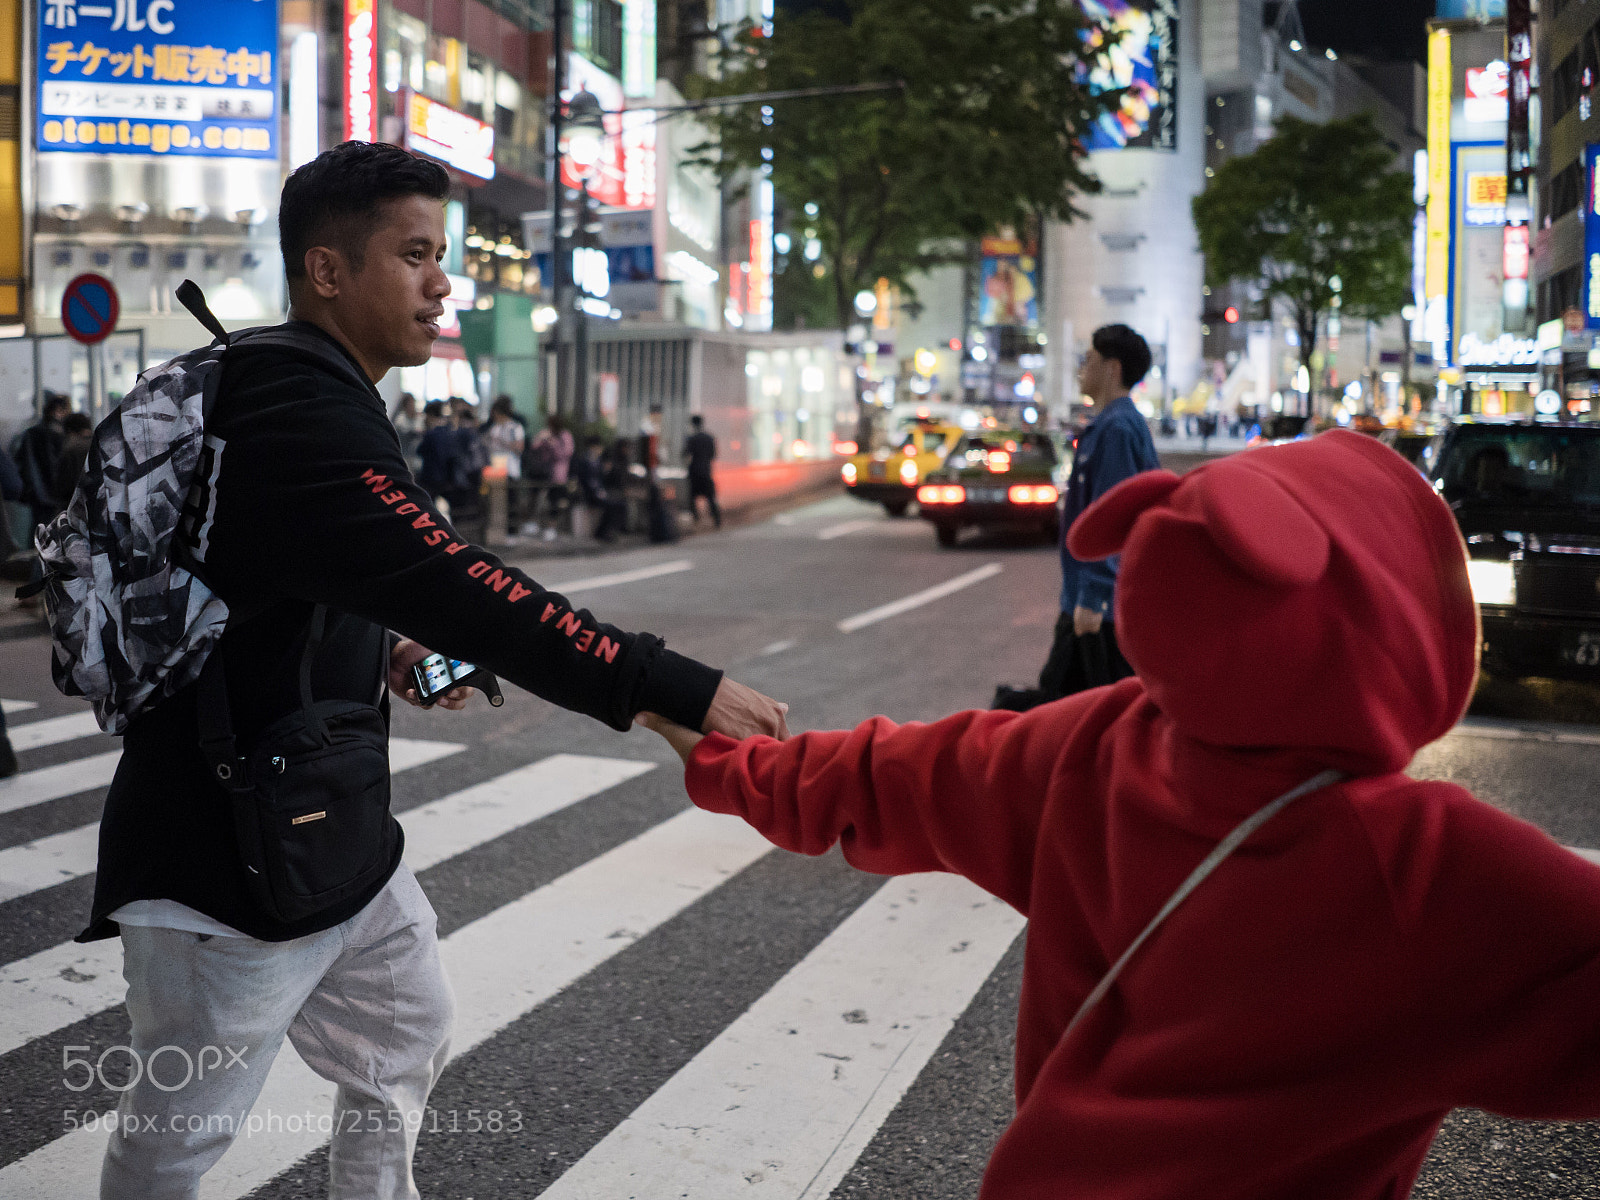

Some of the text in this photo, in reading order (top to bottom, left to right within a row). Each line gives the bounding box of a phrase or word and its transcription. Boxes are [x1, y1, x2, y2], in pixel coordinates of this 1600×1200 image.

[44, 0, 176, 35] ホールC
[45, 41, 272, 87] チケット販売中!
[468, 561, 532, 602] AND
[541, 603, 620, 663] NENA
